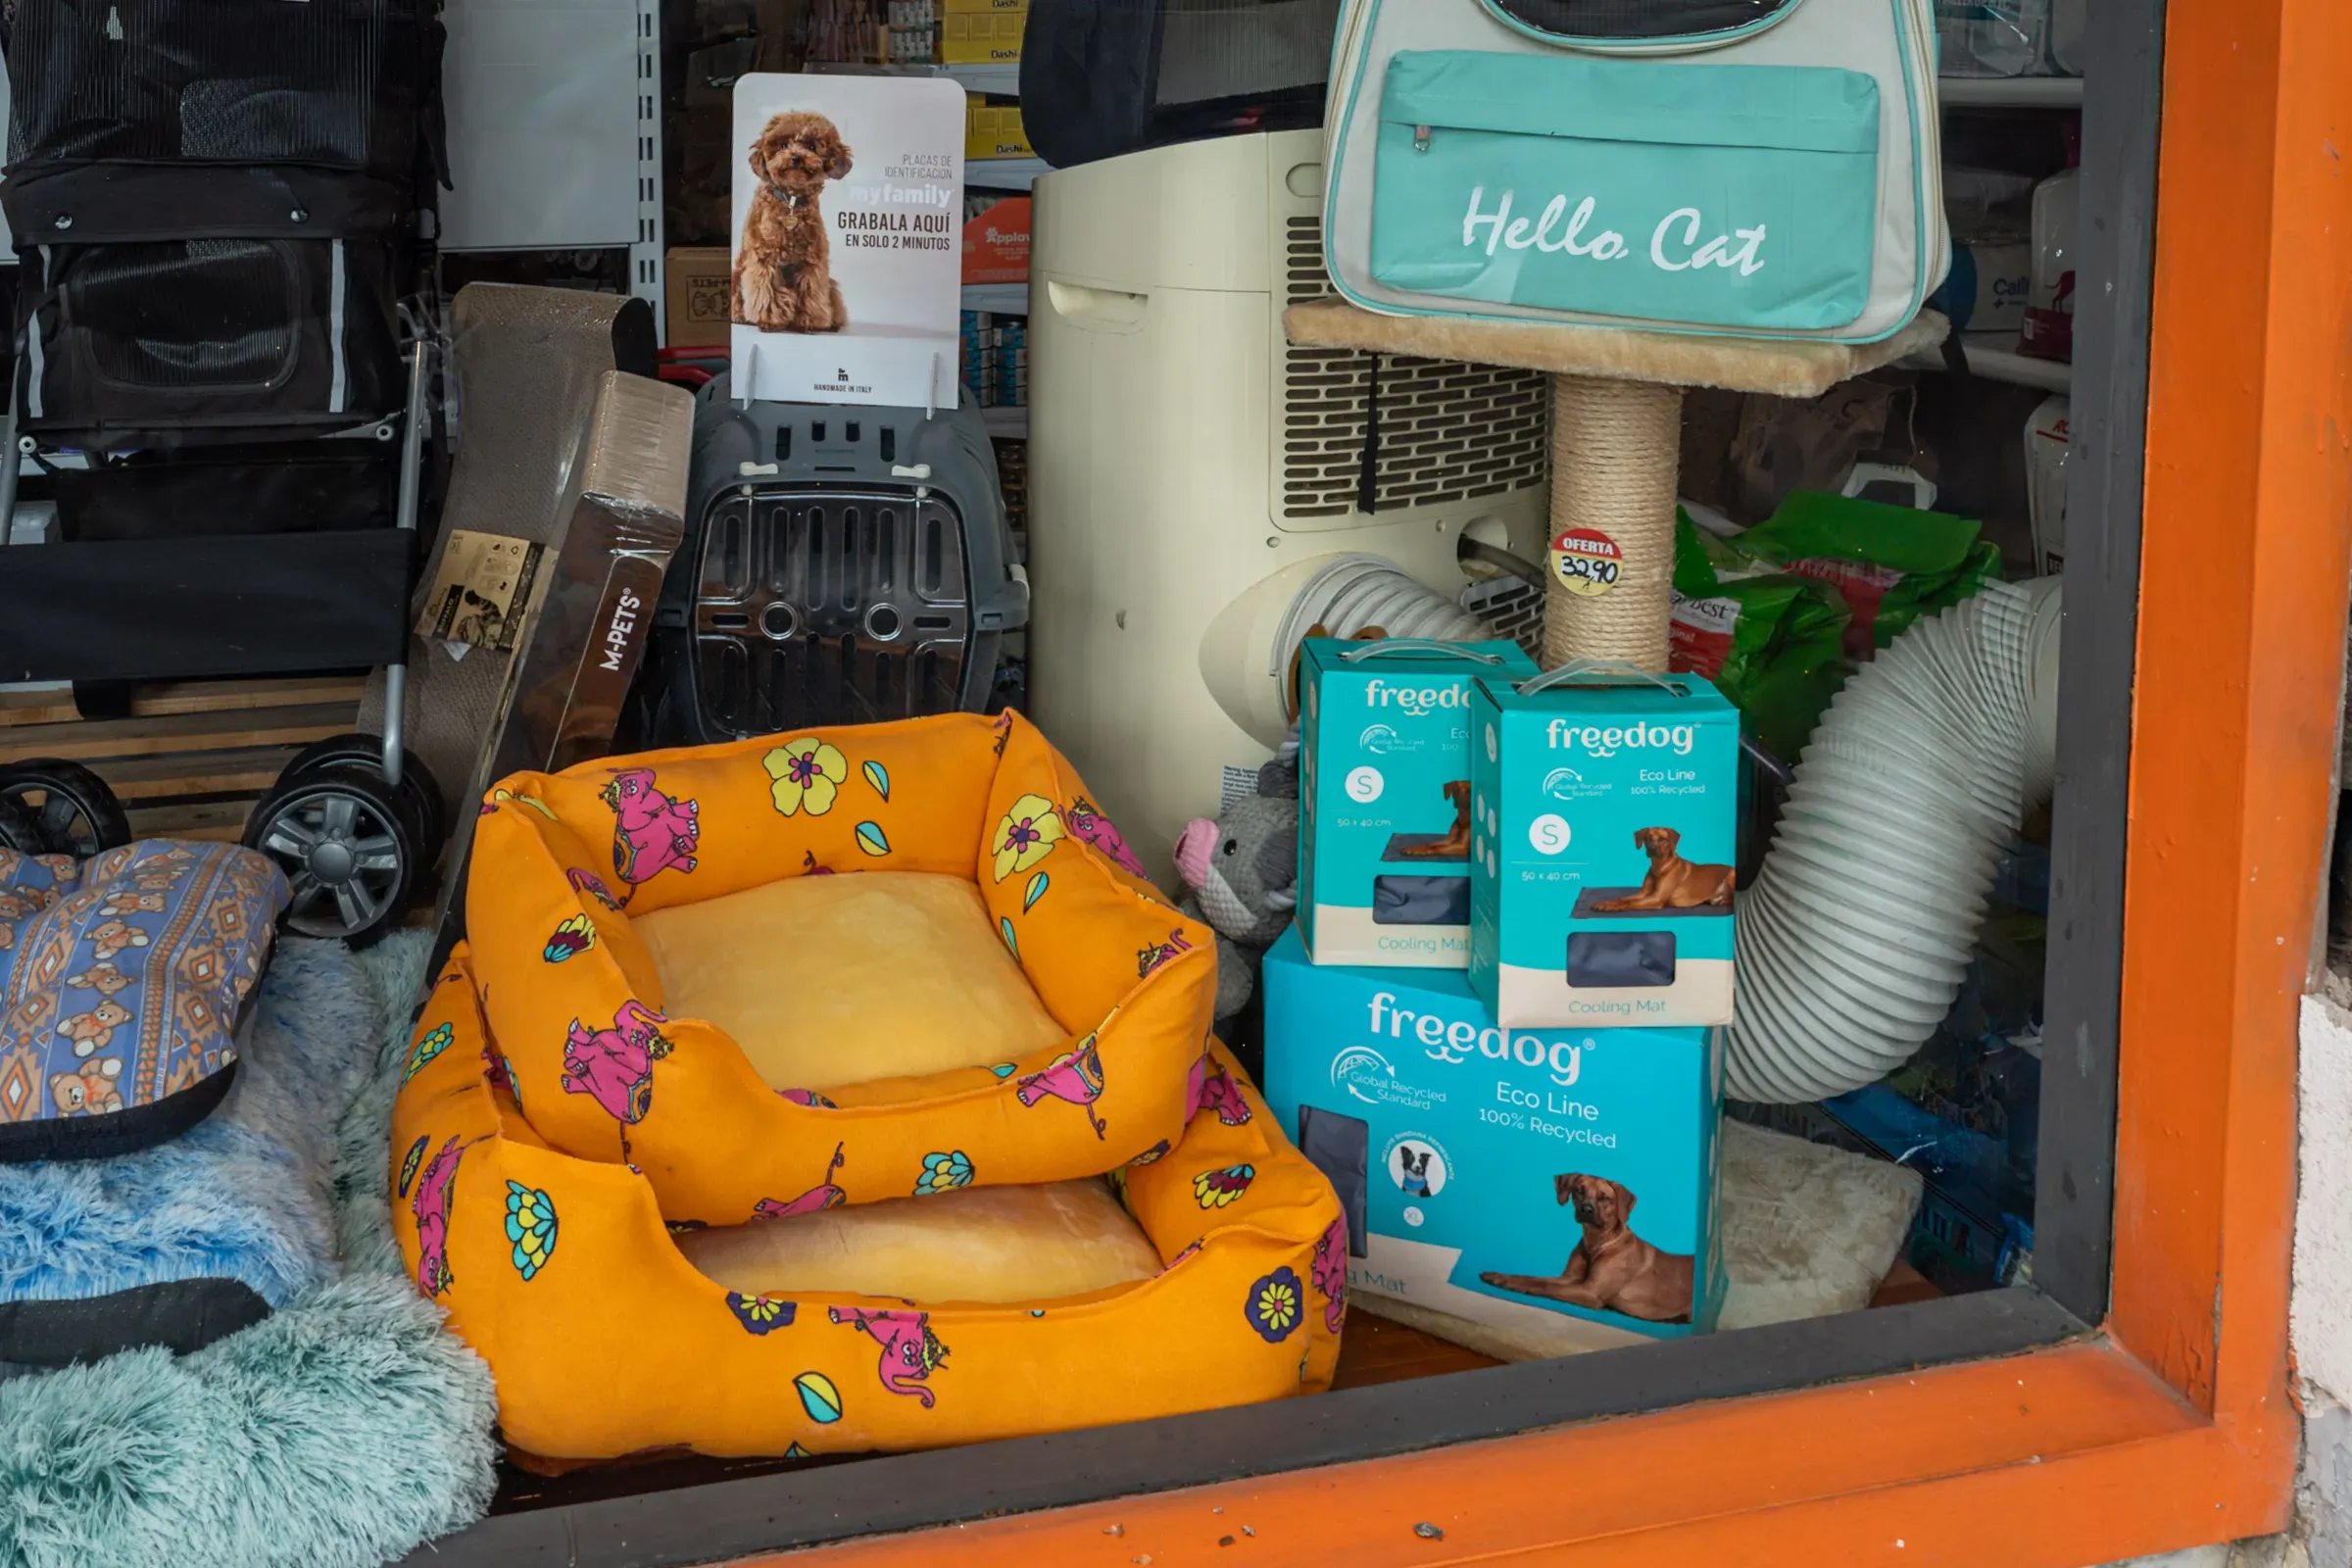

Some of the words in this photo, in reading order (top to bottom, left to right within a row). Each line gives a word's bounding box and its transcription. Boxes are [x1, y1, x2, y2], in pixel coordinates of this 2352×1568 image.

[991, 49, 1017, 59] Dashi
[996, 144, 1023, 154] Dashi
[903, 154, 938, 167] PLACAS
[941, 156, 953, 167] DE
[838, 211, 907, 231] GRABALA
[912, 213, 951, 233] AQUÍ
[846, 233, 859, 247] EN
[862, 234, 889, 248] SOLO
[892, 236, 899, 249] 2
[902, 236, 951, 251] MINUTOS
[1650, 207, 1766, 277] Cat
[813, 383, 847, 392] HANDMADE
[1562, 537, 1614, 556] OFERTA
[1639, 768, 1665, 782] Eco
[1667, 768, 1696, 781] Line
[1356, 774, 1373, 796] S
[1630, 786, 1656, 796] 100%
[1658, 784, 1706, 796] Recycled
[1337, 818, 1349, 827] 50
[1359, 818, 1373, 827] 40
[1542, 823, 1559, 847] S
[1521, 871, 1536, 881] 50
[1546, 871, 1560, 880] 40
[1562, 871, 1581, 880] cm
[1378, 936, 1437, 954] Cooling
[1568, 1000, 1631, 1015] Cooling
[1635, 1000, 1666, 1012] Mat
[1350, 1071, 1389, 1089] Global
[1391, 1080, 1447, 1103] Recycled
[1377, 1089, 1431, 1110] Standard
[1496, 1081, 1541, 1109] Eco
[1547, 1092, 1599, 1121] Line
[1479, 1107, 1525, 1129] 100%
[1530, 1117, 1617, 1149] Recycled
[1364, 1269, 1407, 1295] Mat
